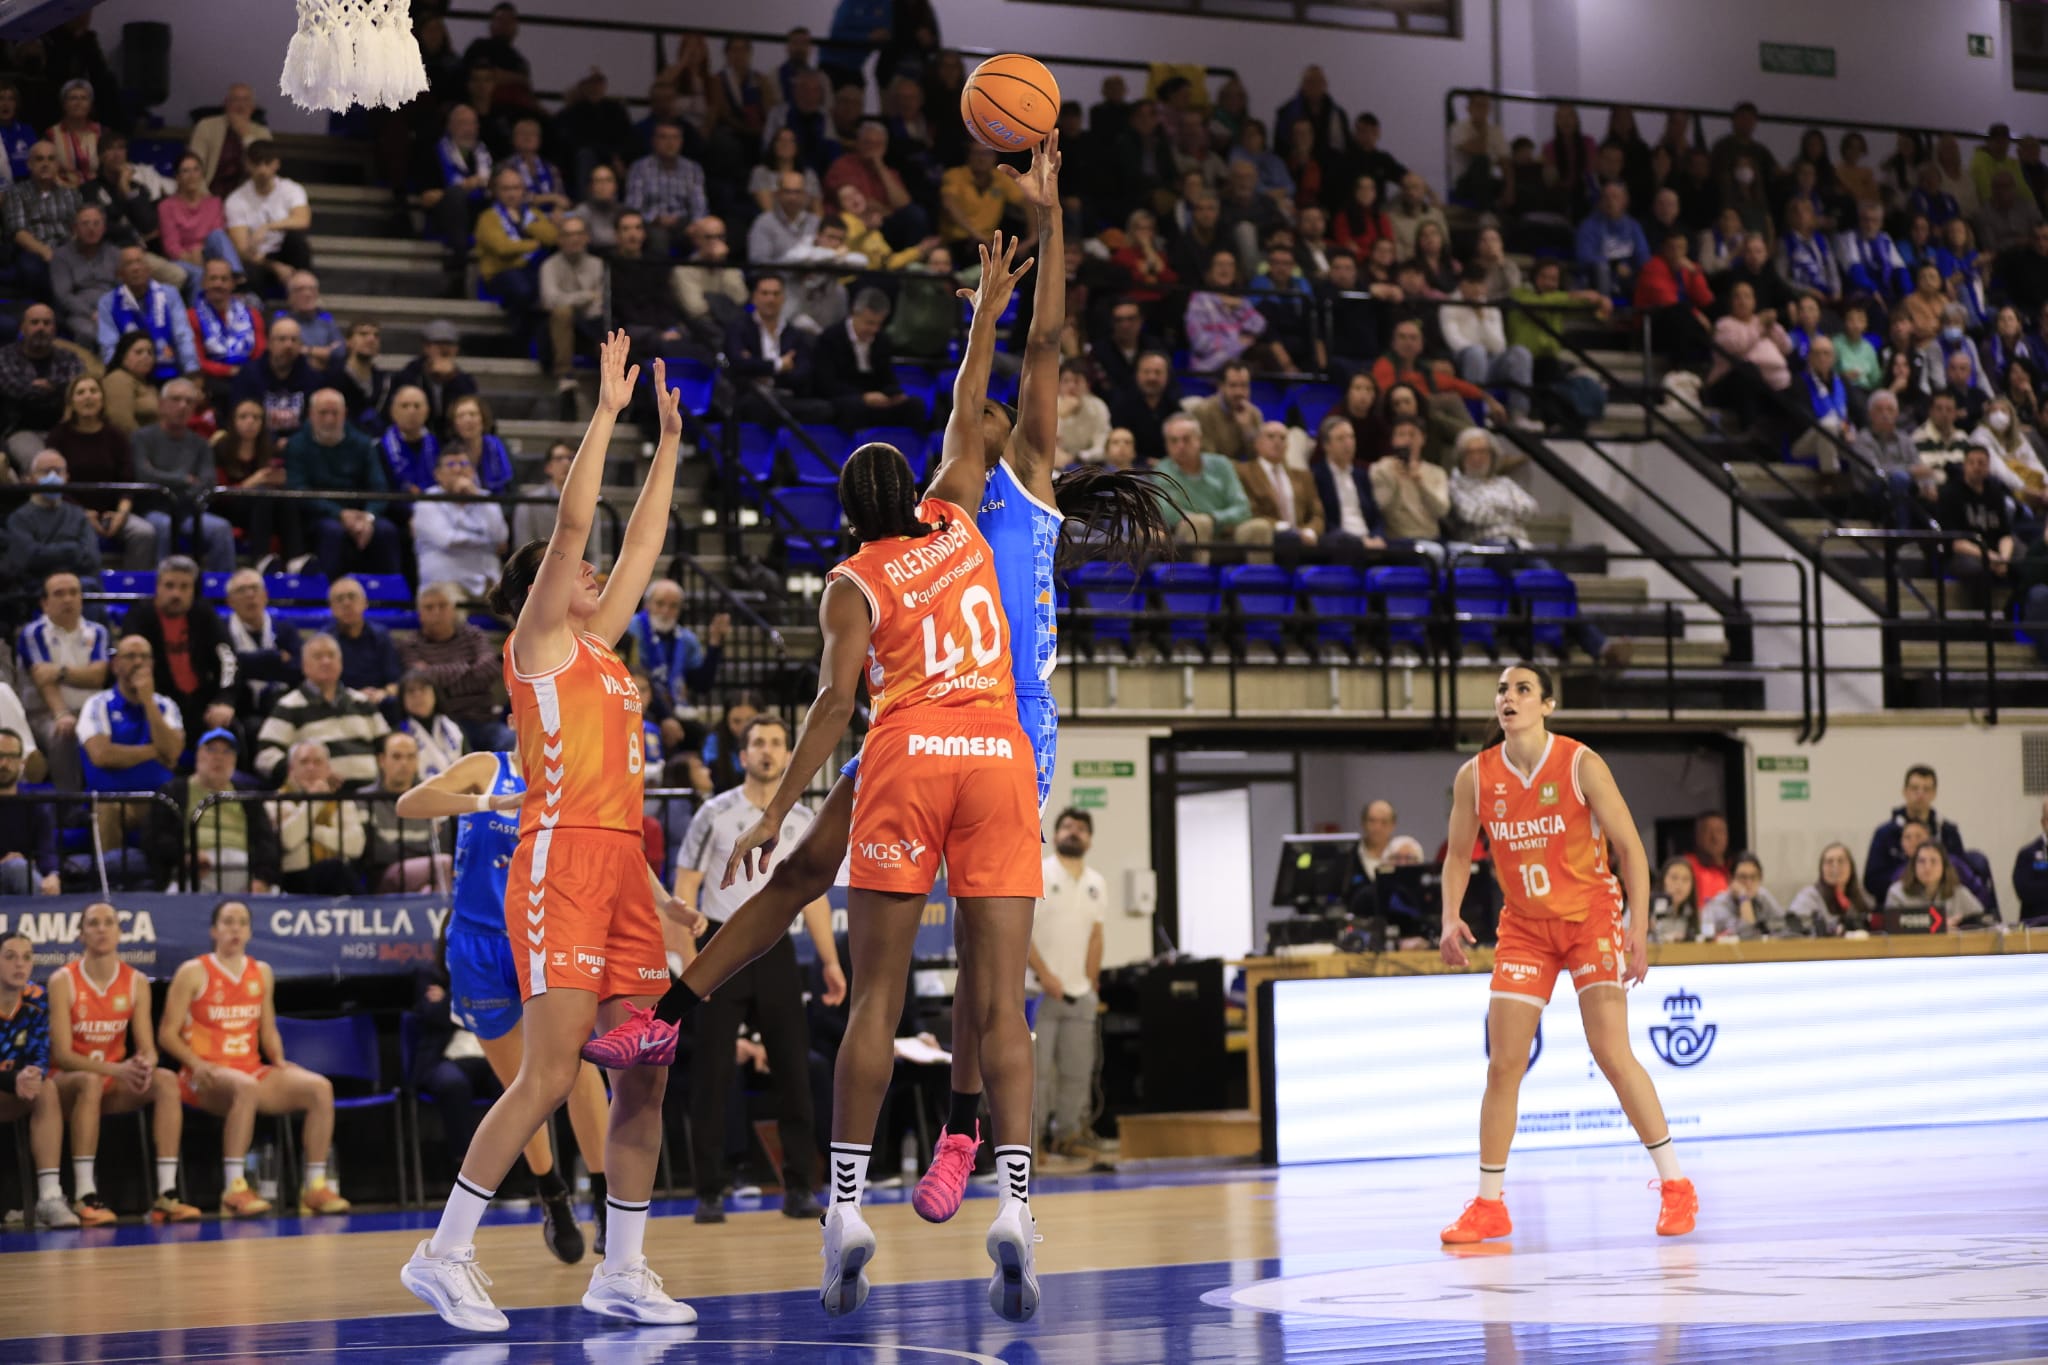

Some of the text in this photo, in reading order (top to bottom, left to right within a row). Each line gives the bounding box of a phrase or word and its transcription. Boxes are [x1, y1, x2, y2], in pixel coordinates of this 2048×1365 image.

[884, 518, 973, 586] ALEXANDER
[921, 584, 1001, 679] 40
[628, 731, 642, 774] 8
[908, 734, 1014, 760] PAMESA
[1489, 814, 1566, 841] VALENCIA
[859, 842, 901, 861] MGS
[1509, 837, 1549, 852] BASKET
[1519, 863, 1551, 898] 10
[270, 907, 449, 940] CASTILLA Y
[341, 942, 377, 959] NOS
[1502, 962, 1538, 975] PULEVA
